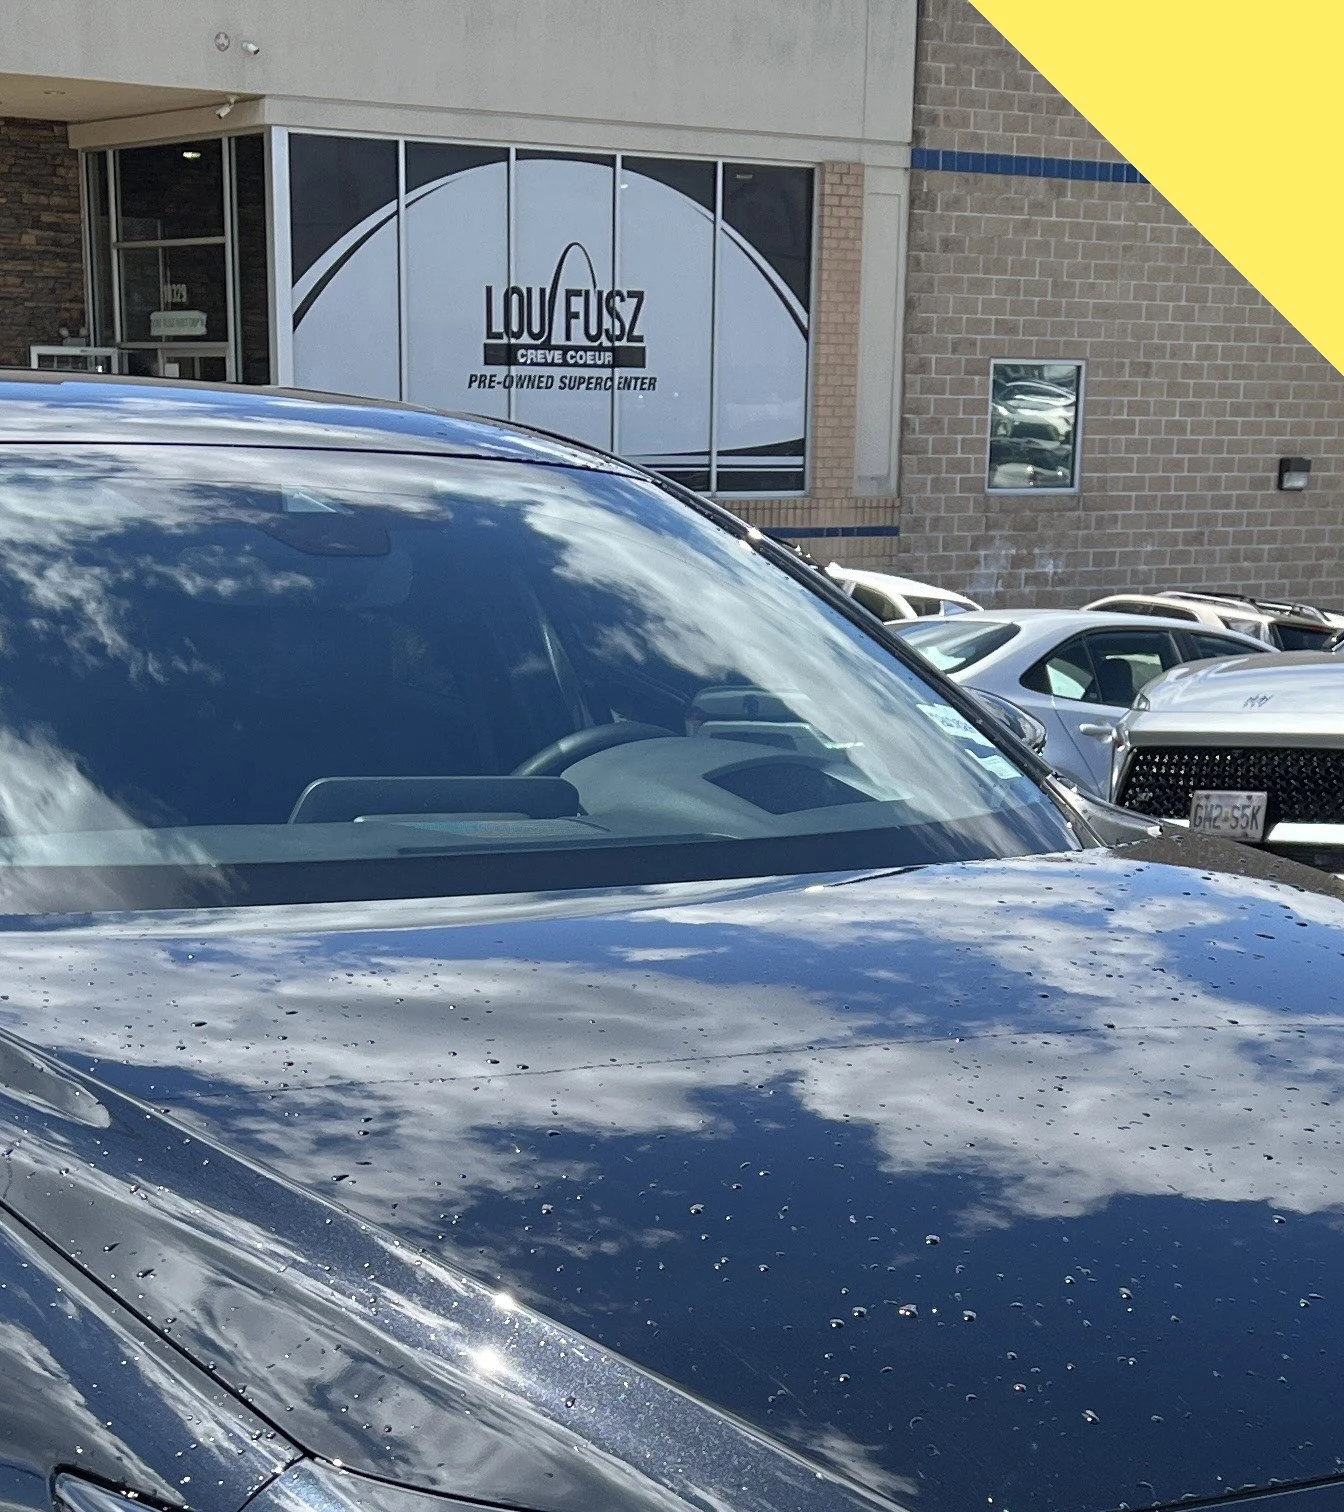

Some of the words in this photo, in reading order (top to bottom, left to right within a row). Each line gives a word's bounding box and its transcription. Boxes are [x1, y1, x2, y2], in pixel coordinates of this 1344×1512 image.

[485, 285, 547, 341] LOU
[565, 288, 645, 344] FUSZ
[517, 349, 562, 364] CREVE
[566, 351, 614, 365] COEUR
[468, 374, 555, 390] PRE-OWNED
